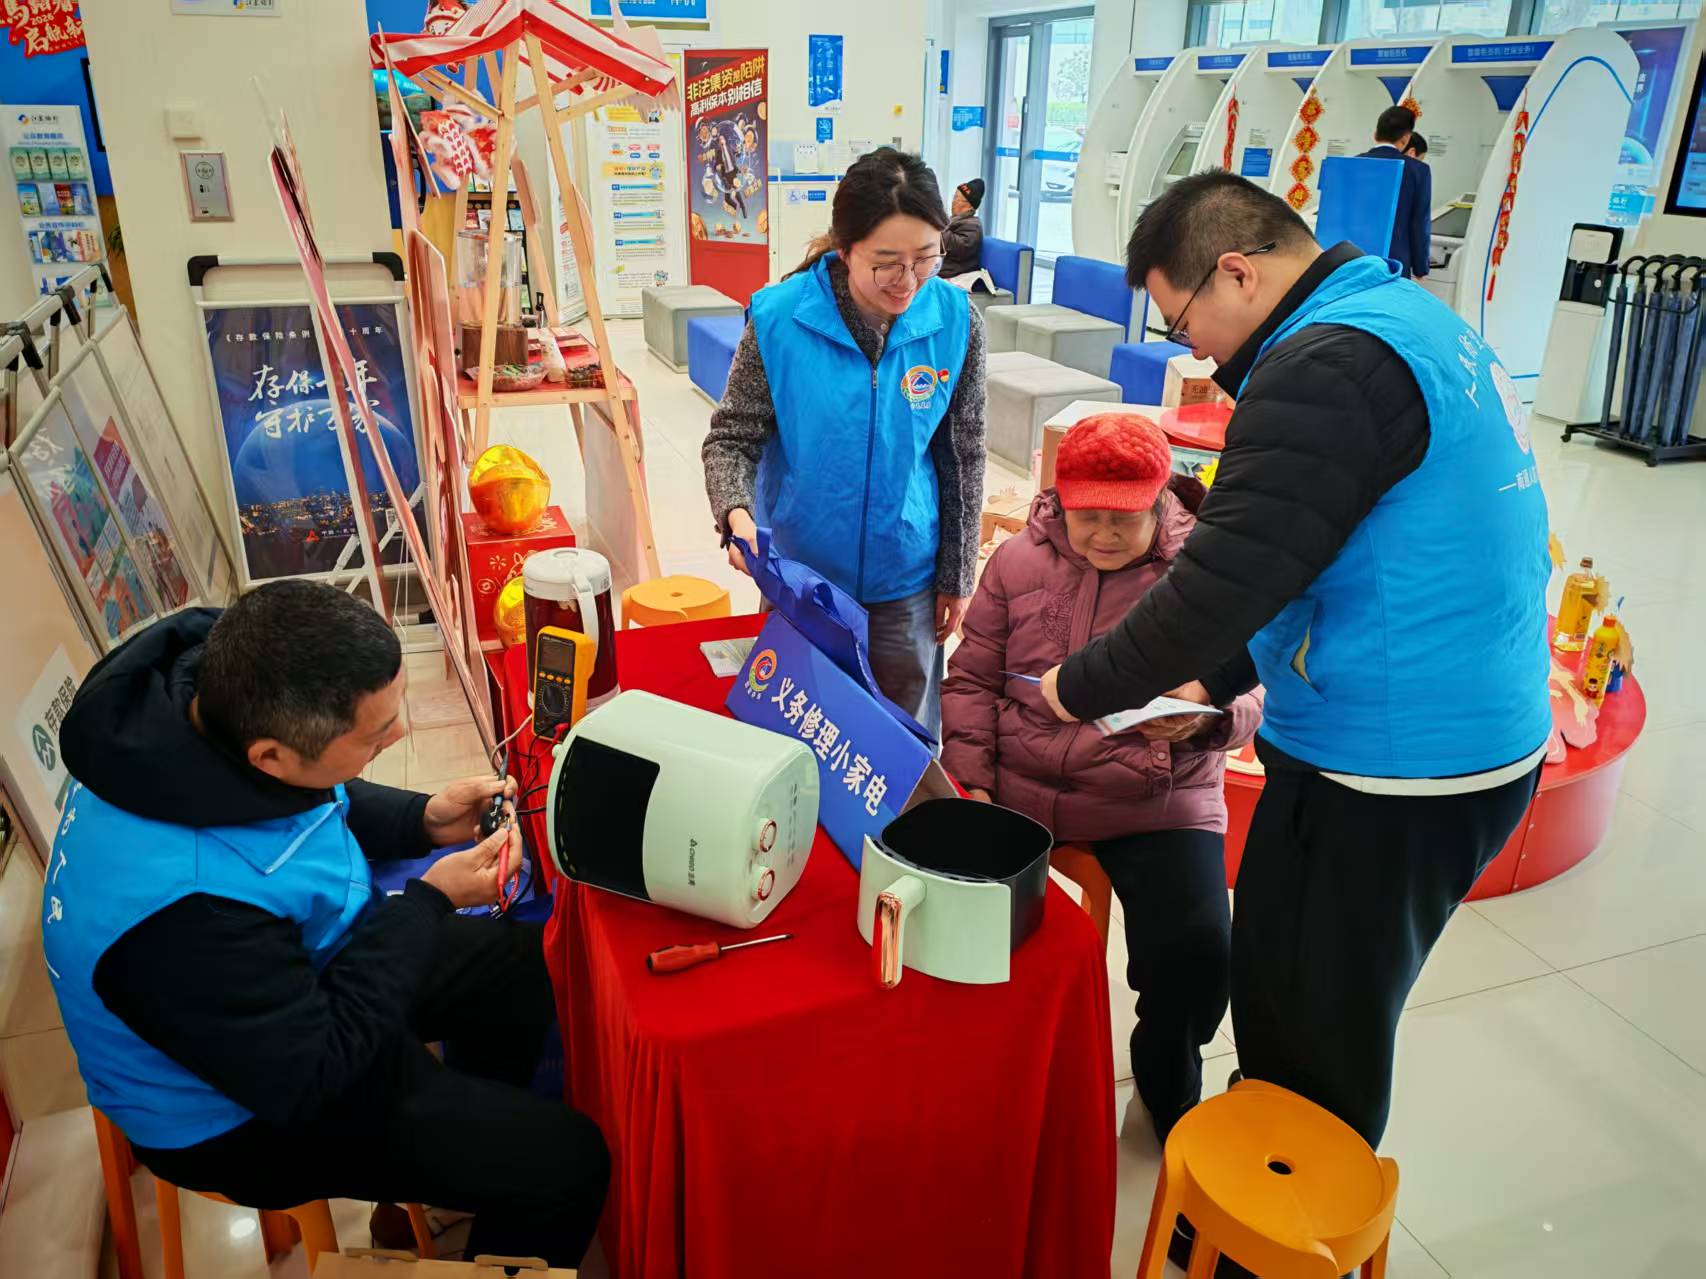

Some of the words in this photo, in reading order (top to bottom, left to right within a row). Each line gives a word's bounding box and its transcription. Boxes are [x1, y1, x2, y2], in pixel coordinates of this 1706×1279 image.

[687, 55, 765, 101] 非法集资是陷阱
[690, 78, 762, 117] 高利保本别相信
[771, 677, 888, 817] 义务修理小家电
